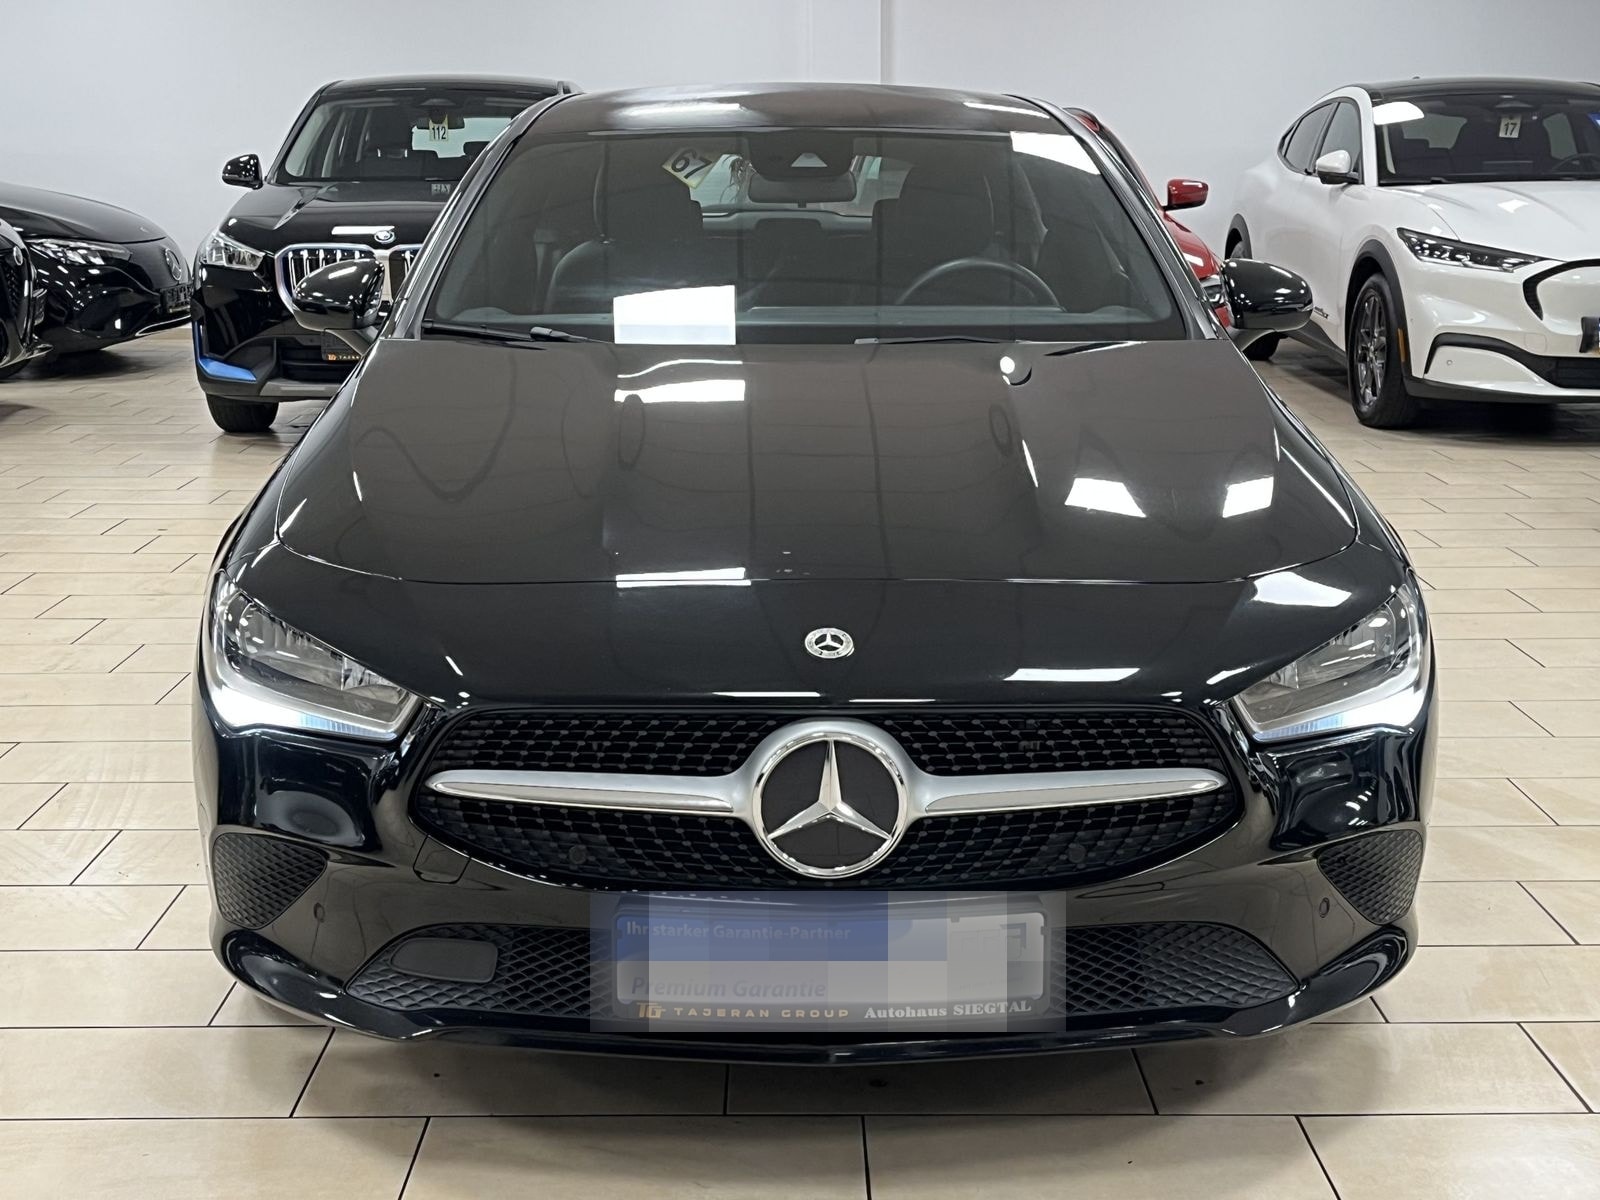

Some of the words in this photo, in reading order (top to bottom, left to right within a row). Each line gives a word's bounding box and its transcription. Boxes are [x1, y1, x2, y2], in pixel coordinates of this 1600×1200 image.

[431, 125, 447, 140] 112
[1504, 122, 1517, 136] 17
[671, 148, 713, 180] 67
[626, 921, 649, 935] Ihr
[652, 923, 709, 937] starker
[713, 924, 851, 940] Garantie-Partner
[631, 977, 726, 998] Premium
[732, 979, 826, 998] Garantie
[674, 1007, 769, 1018] TAJERAN
[781, 1008, 849, 1019] GROUP
[864, 1006, 947, 1019] Autohaus
[953, 1000, 1032, 1016] SIEGTAL
